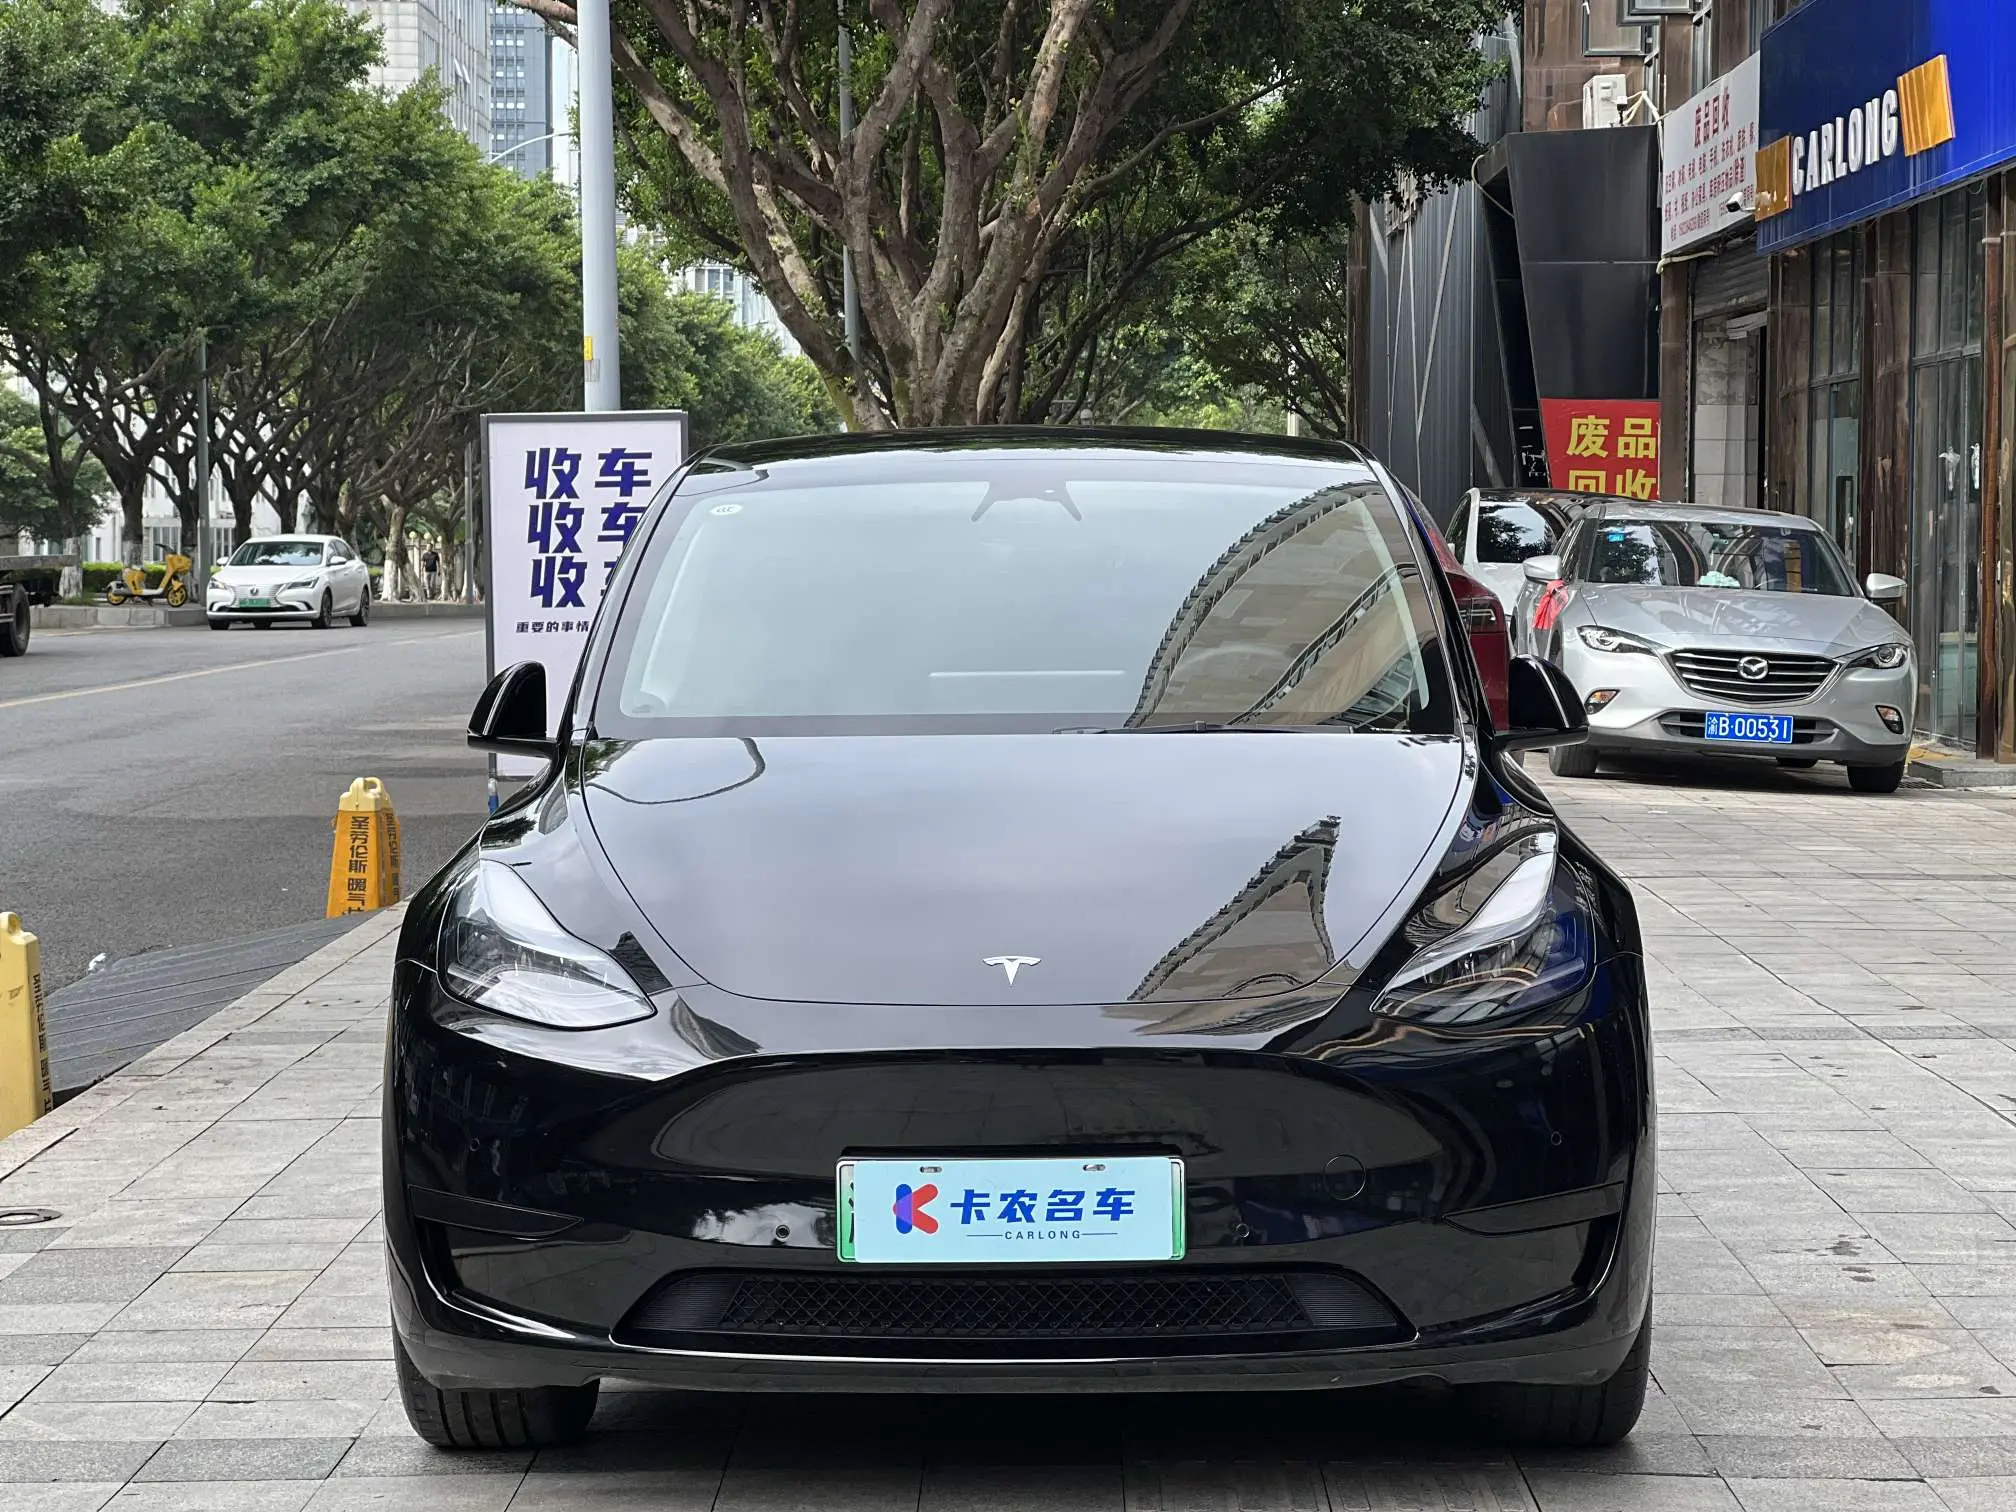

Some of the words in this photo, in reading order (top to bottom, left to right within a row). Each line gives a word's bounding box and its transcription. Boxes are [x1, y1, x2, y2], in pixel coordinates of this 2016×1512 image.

[1694, 85, 1731, 149] 废品回收
[1792, 90, 1898, 196] CARLONG
[1567, 415, 1656, 459] 废品
[524, 447, 653, 499] 收车
[530, 555, 619, 608] 收
[515, 620, 589, 634] 重要的事情
[950, 1187, 1136, 1225] 卡农名车
[1004, 1230, 1081, 1240] CARLONG
